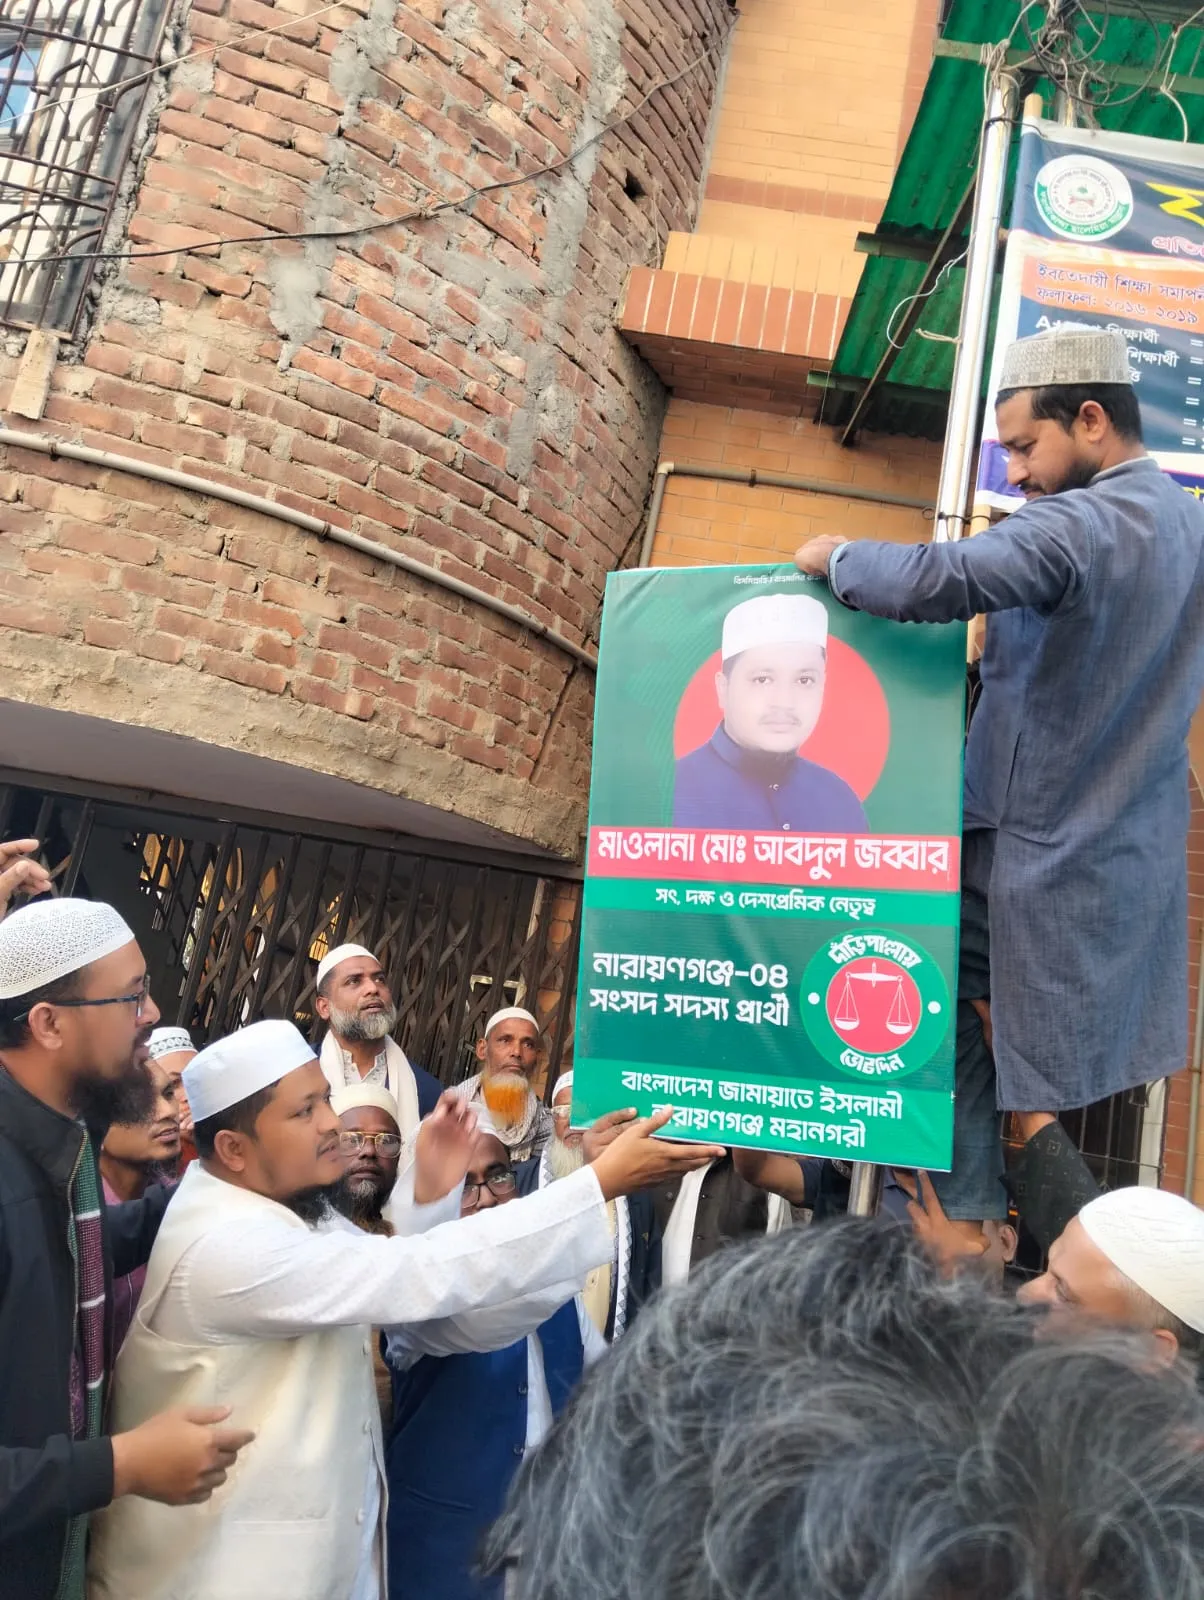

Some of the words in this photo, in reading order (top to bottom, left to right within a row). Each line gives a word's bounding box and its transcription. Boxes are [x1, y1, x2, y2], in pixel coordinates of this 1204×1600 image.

[1114, 273, 1152, 294] শিক্ষা
[597, 830, 696, 862] মাওলানা
[701, 832, 747, 865] মোঃ
[753, 835, 848, 881] আবদুল
[854, 838, 949, 875] জব্বার
[685, 889, 716, 907] দক্ষ
[719, 891, 735, 907] ও
[738, 888, 825, 912] দেশপ্রেমিক
[829, 896, 877, 921] নেতৃত্ব
[589, 988, 658, 1016] সংসদ
[663, 993, 729, 1022] সদস্য
[734, 992, 790, 1027] প্রার্থী
[621, 1070, 713, 1099] বাংলাদেশ
[718, 1079, 814, 1110] জামায়াতে
[819, 1084, 903, 1120] ইসলামী
[769, 1118, 867, 1148] মহানগরী
